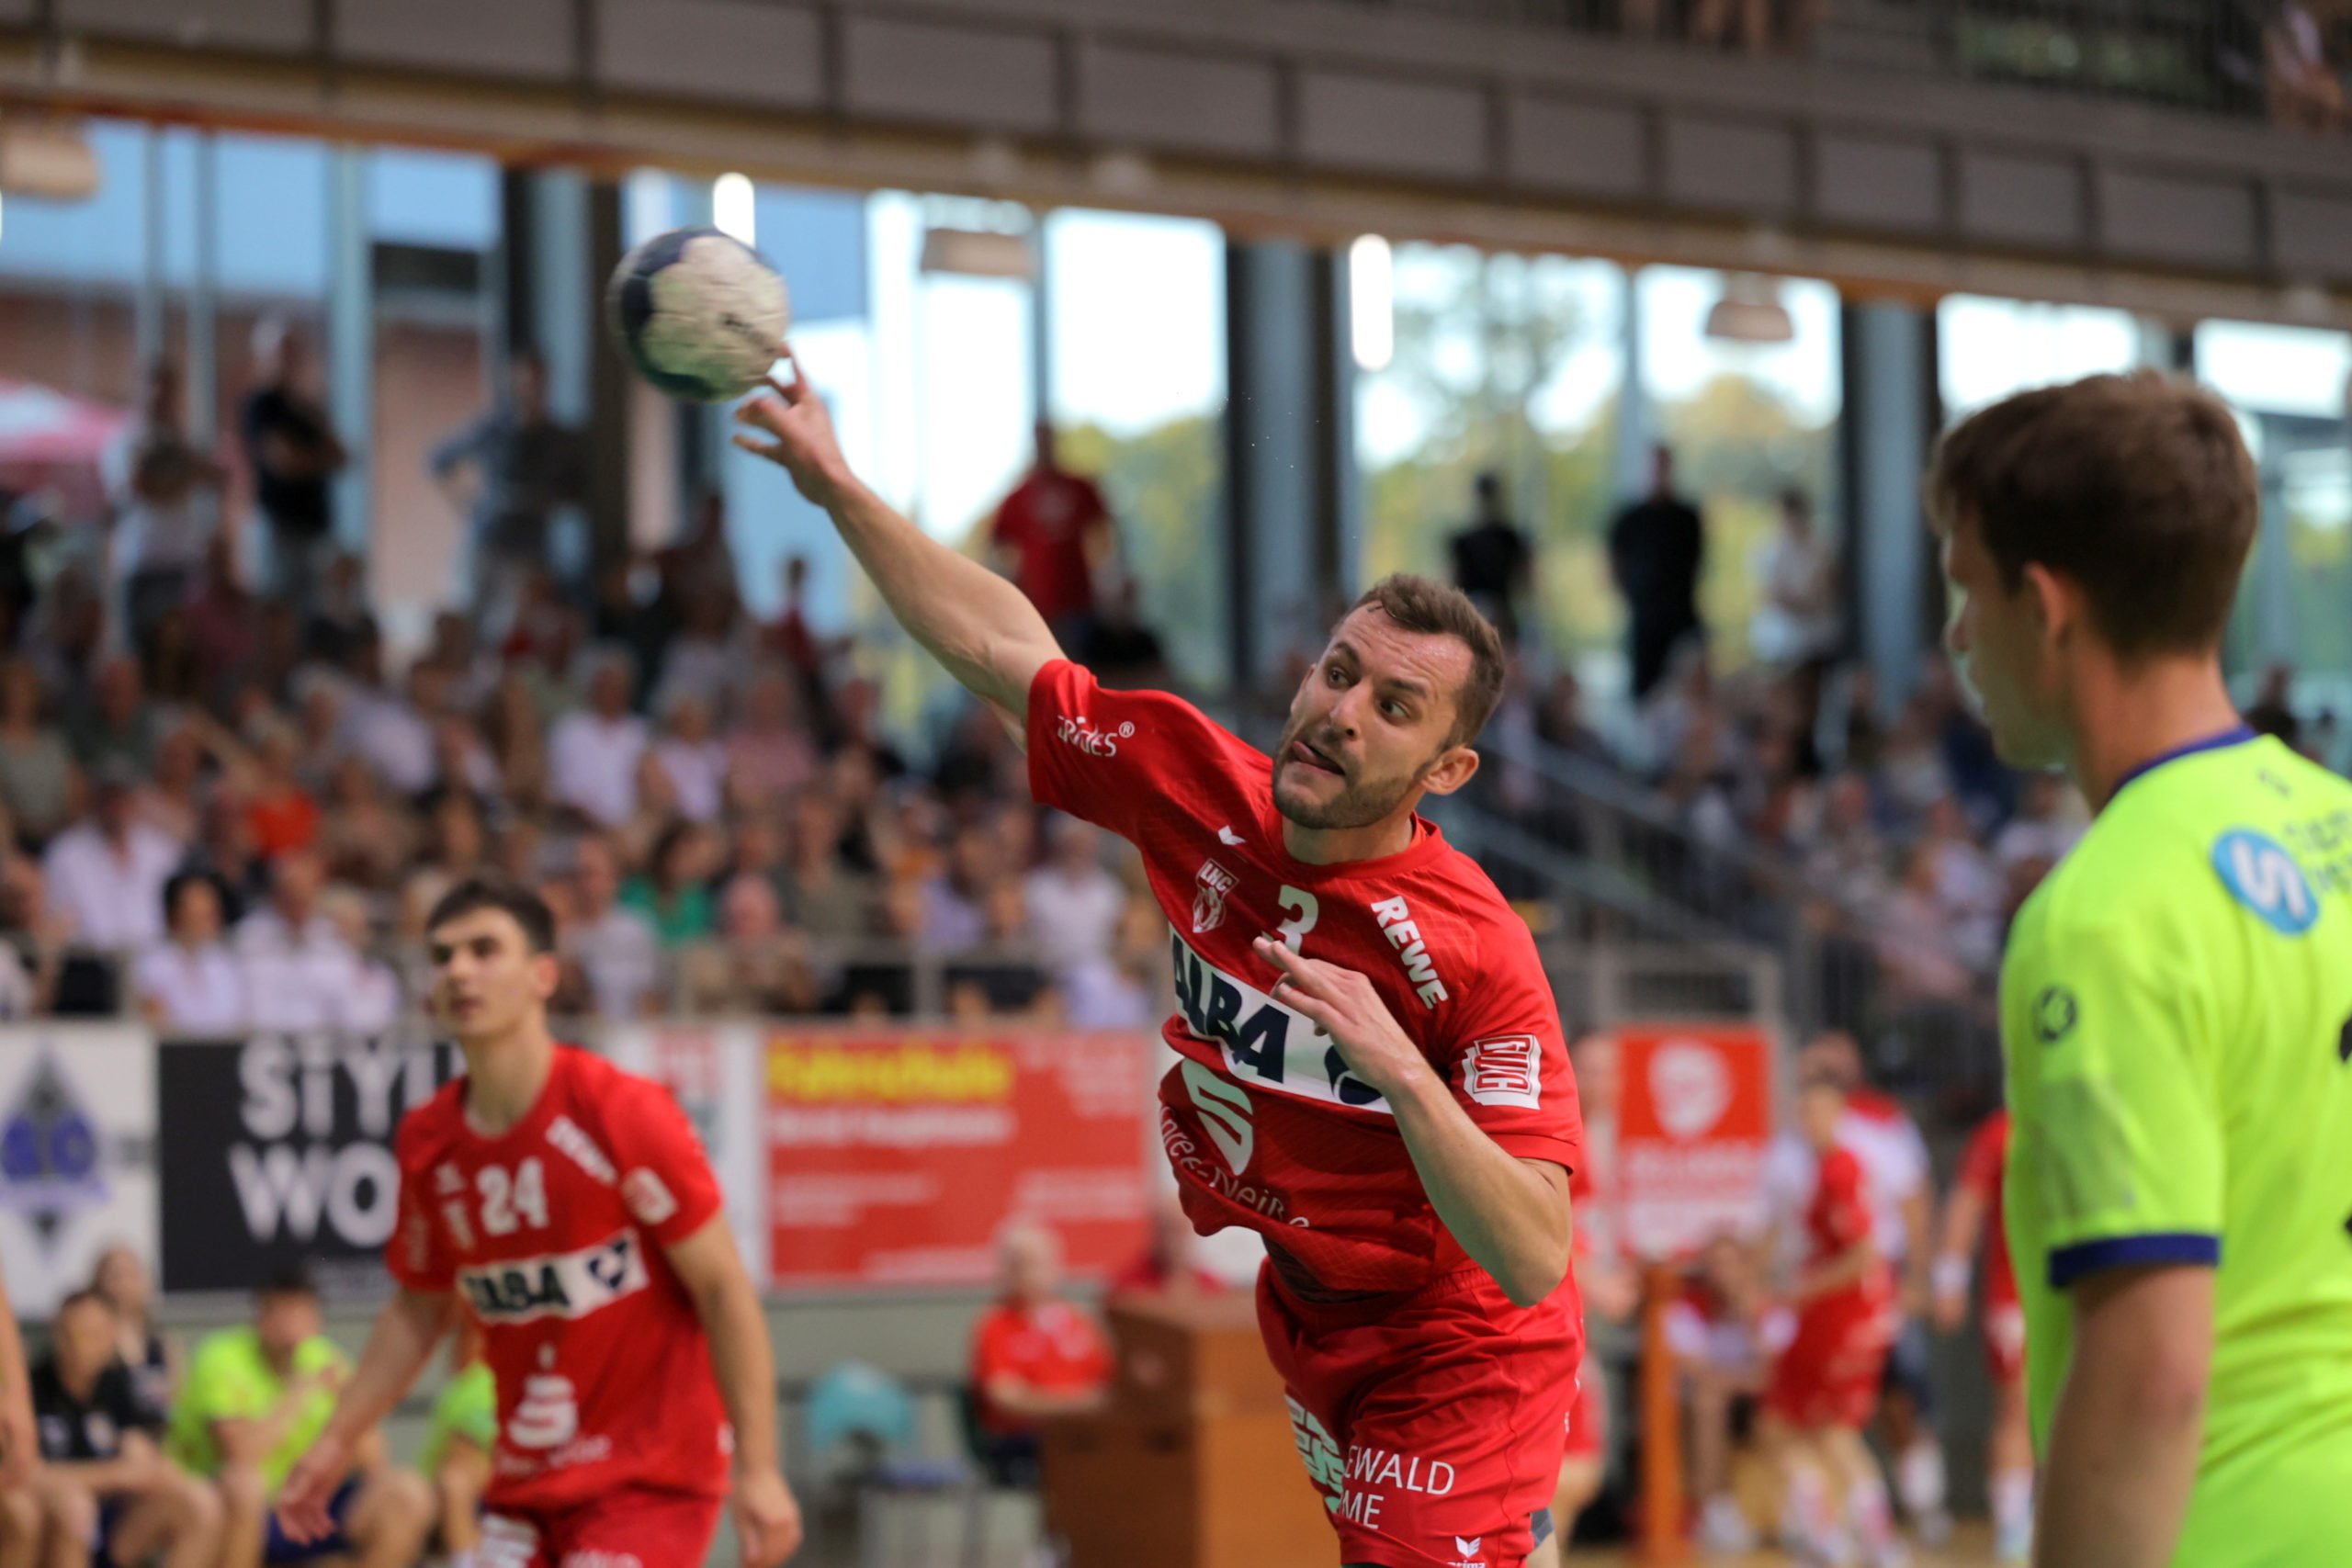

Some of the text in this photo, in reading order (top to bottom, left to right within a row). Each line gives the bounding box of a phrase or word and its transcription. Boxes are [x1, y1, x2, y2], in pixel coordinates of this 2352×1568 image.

[1200, 863, 1233, 892] LHC
[1261, 884, 1318, 956] 3
[1371, 896, 1449, 1010] REWE
[227, 1144, 401, 1248] WO
[476, 1157, 548, 1235] 24
[1343, 1444, 1454, 1495] EWALD
[1340, 1489, 1384, 1529] ME
